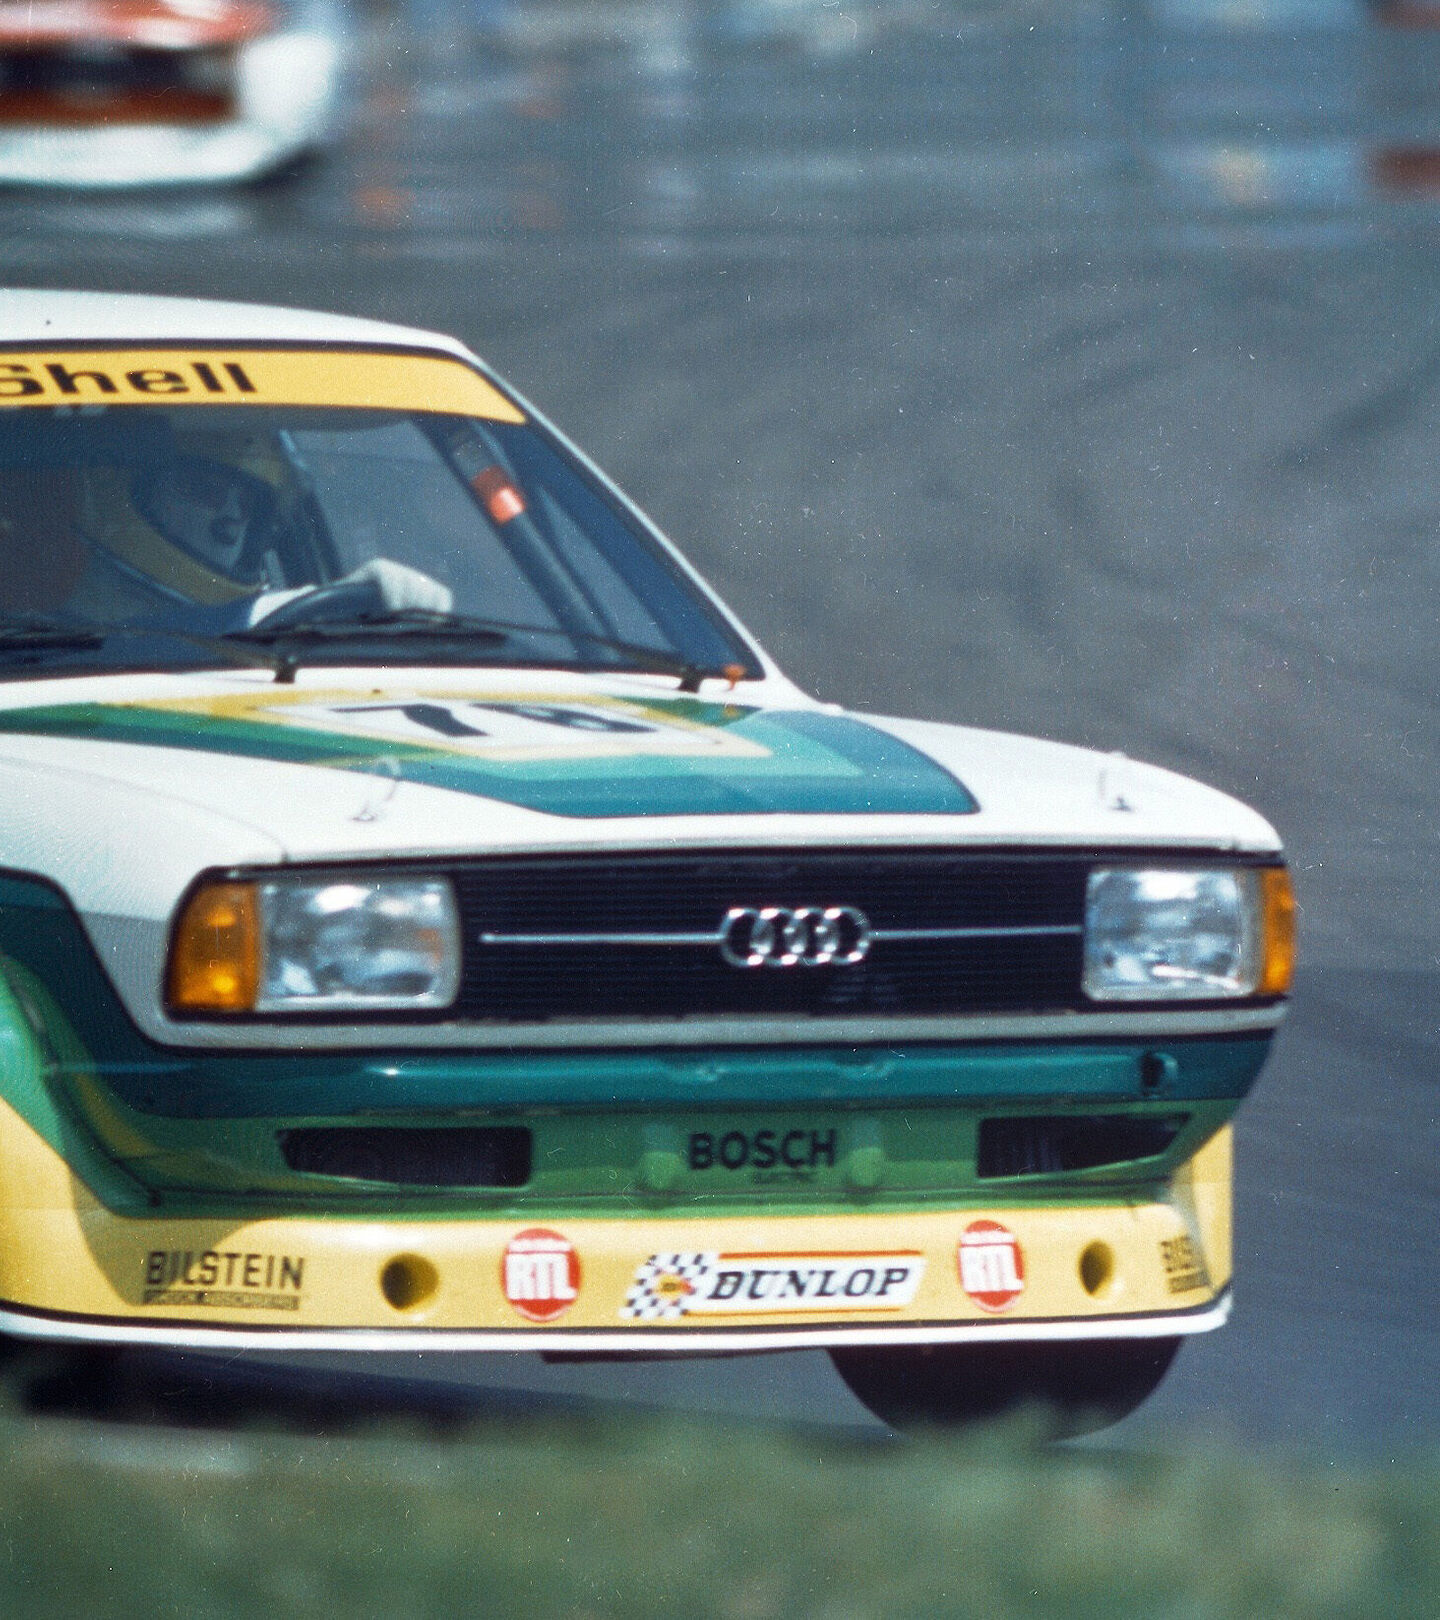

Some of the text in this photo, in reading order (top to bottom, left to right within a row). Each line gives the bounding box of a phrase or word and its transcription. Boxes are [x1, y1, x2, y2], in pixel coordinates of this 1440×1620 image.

[332, 702, 659, 737] 78
[689, 1128, 837, 1171] BOSCH
[147, 1250, 305, 1290] BILSTEIN
[506, 1252, 578, 1300] RTL
[710, 1267, 910, 1301] DUNLOP
